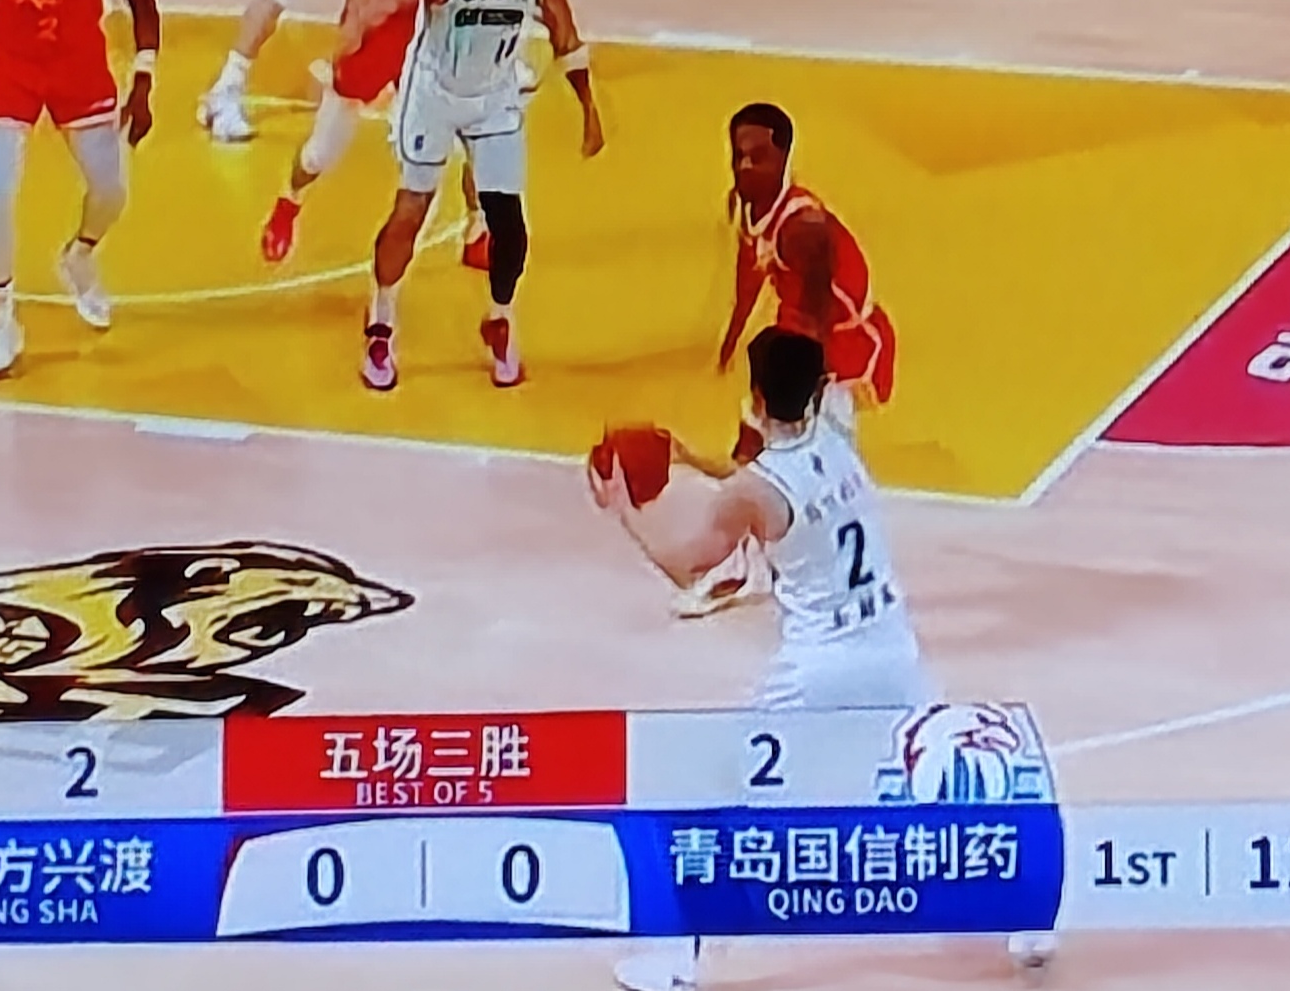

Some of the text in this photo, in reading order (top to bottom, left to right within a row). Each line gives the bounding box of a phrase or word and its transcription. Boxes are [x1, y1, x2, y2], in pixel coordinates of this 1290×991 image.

[837, 519, 876, 591] 2
[64, 747, 98, 798] 2
[320, 725, 531, 779] 五场三胜
[748, 733, 785, 786] 2
[356, 781, 494, 806] BEST OF 5
[306, 845, 540, 906] 0 0
[669, 823, 1017, 885] 青岛国信制药
[1093, 841, 1176, 886] 1ST
[39, 899, 98, 924] SHA
[768, 887, 918, 919] QING DAO
